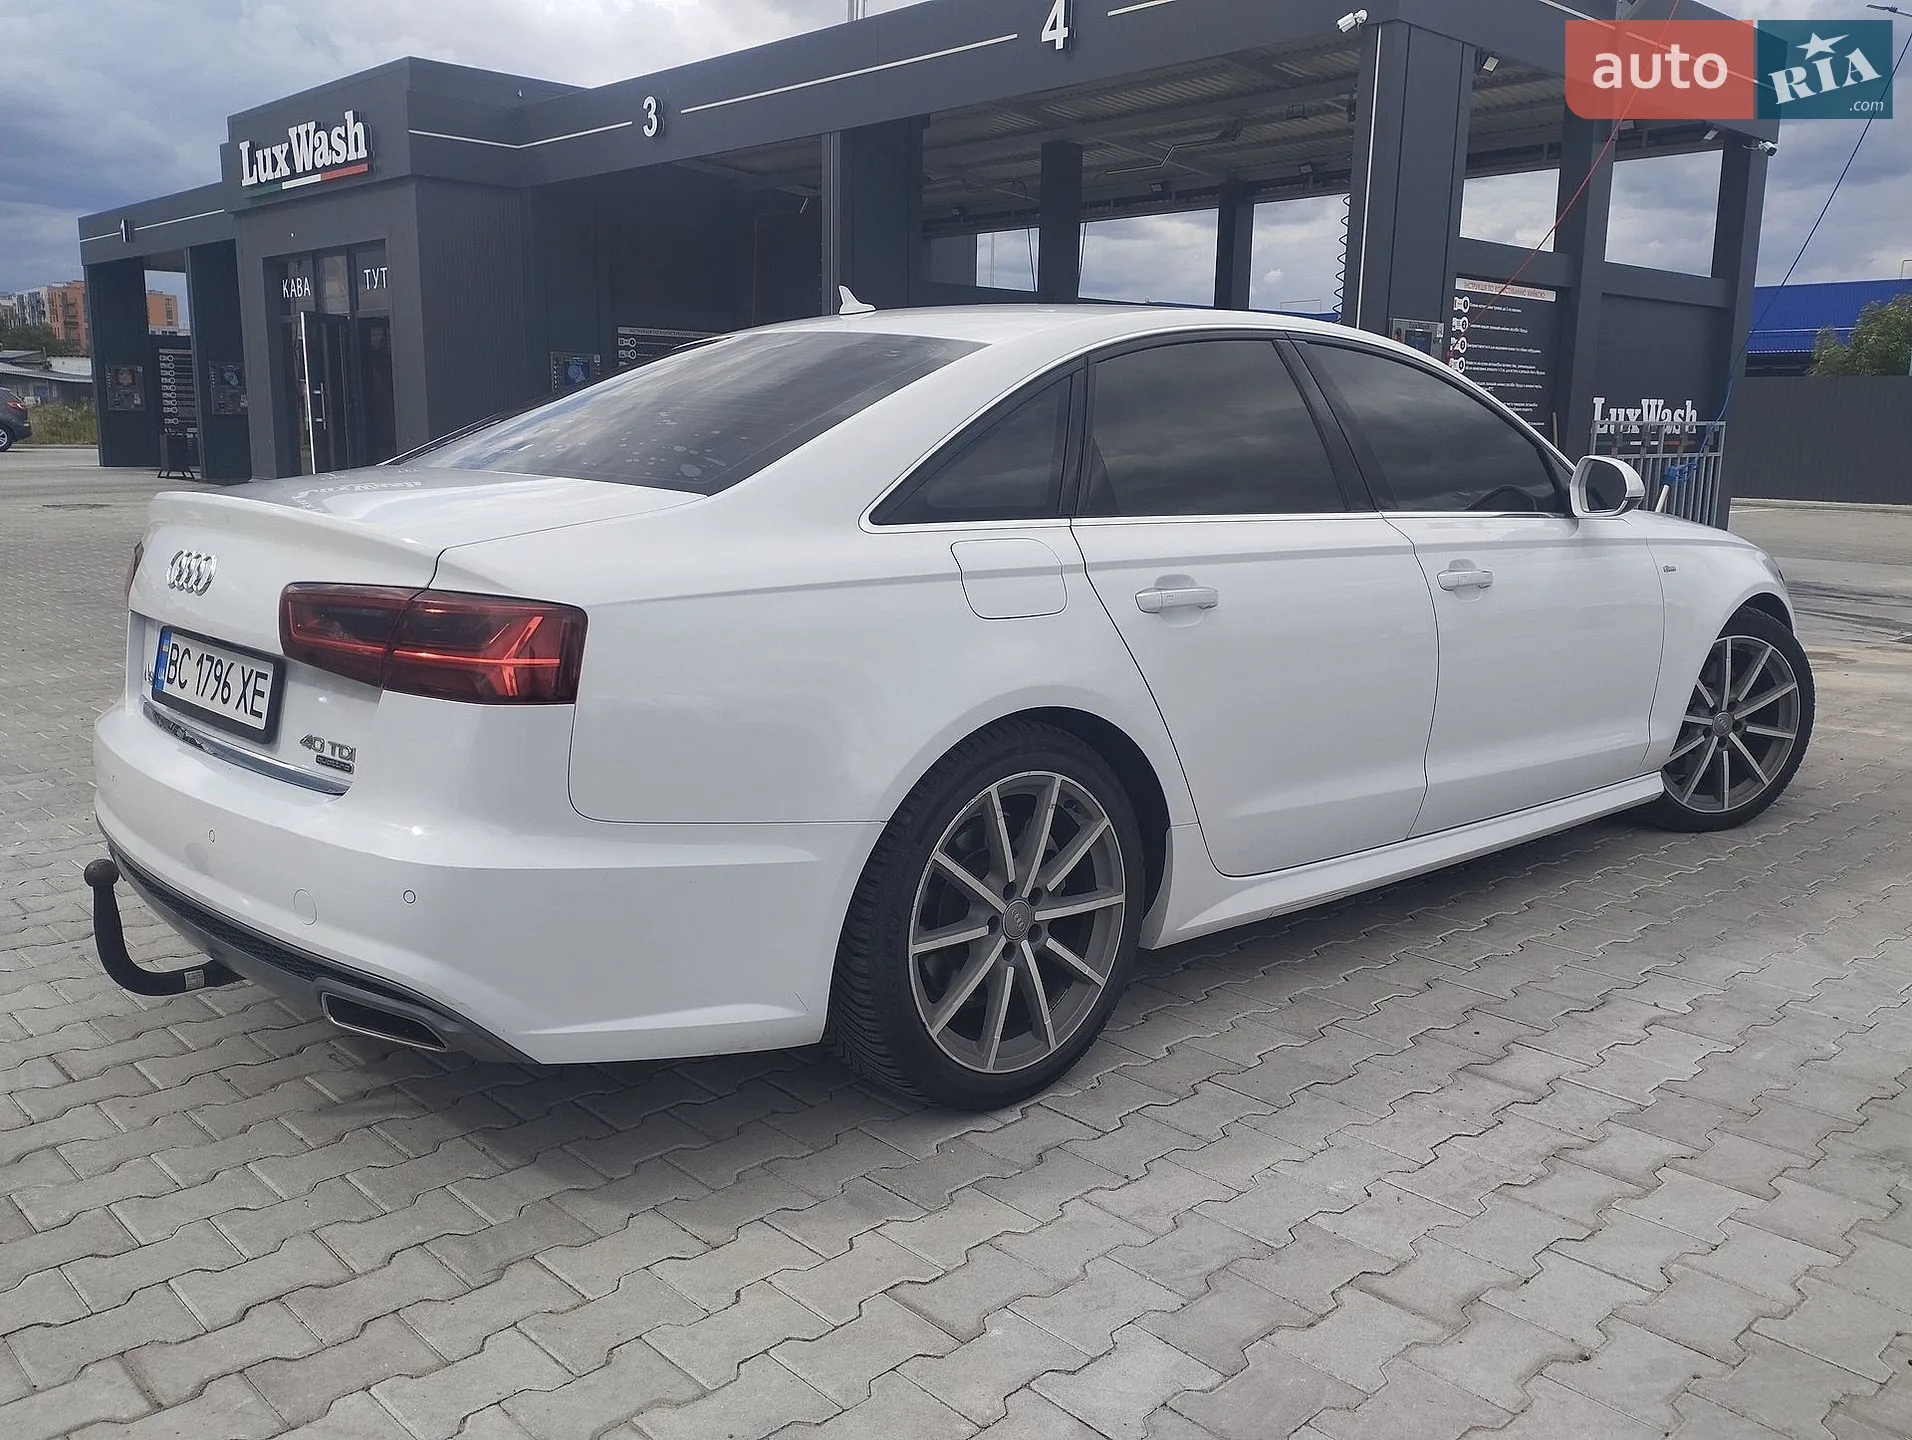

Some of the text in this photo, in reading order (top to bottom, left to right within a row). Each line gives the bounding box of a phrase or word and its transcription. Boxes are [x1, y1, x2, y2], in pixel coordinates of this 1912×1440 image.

[1042, 0, 1068, 50] 4
[643, 96, 658, 137] 3
[282, 267, 388, 298] КАВА ТУТ
[166, 643, 191, 689] BC
[196, 652, 235, 705] 1796
[235, 665, 269, 719] XE
[300, 734, 356, 763] 40 TDI
